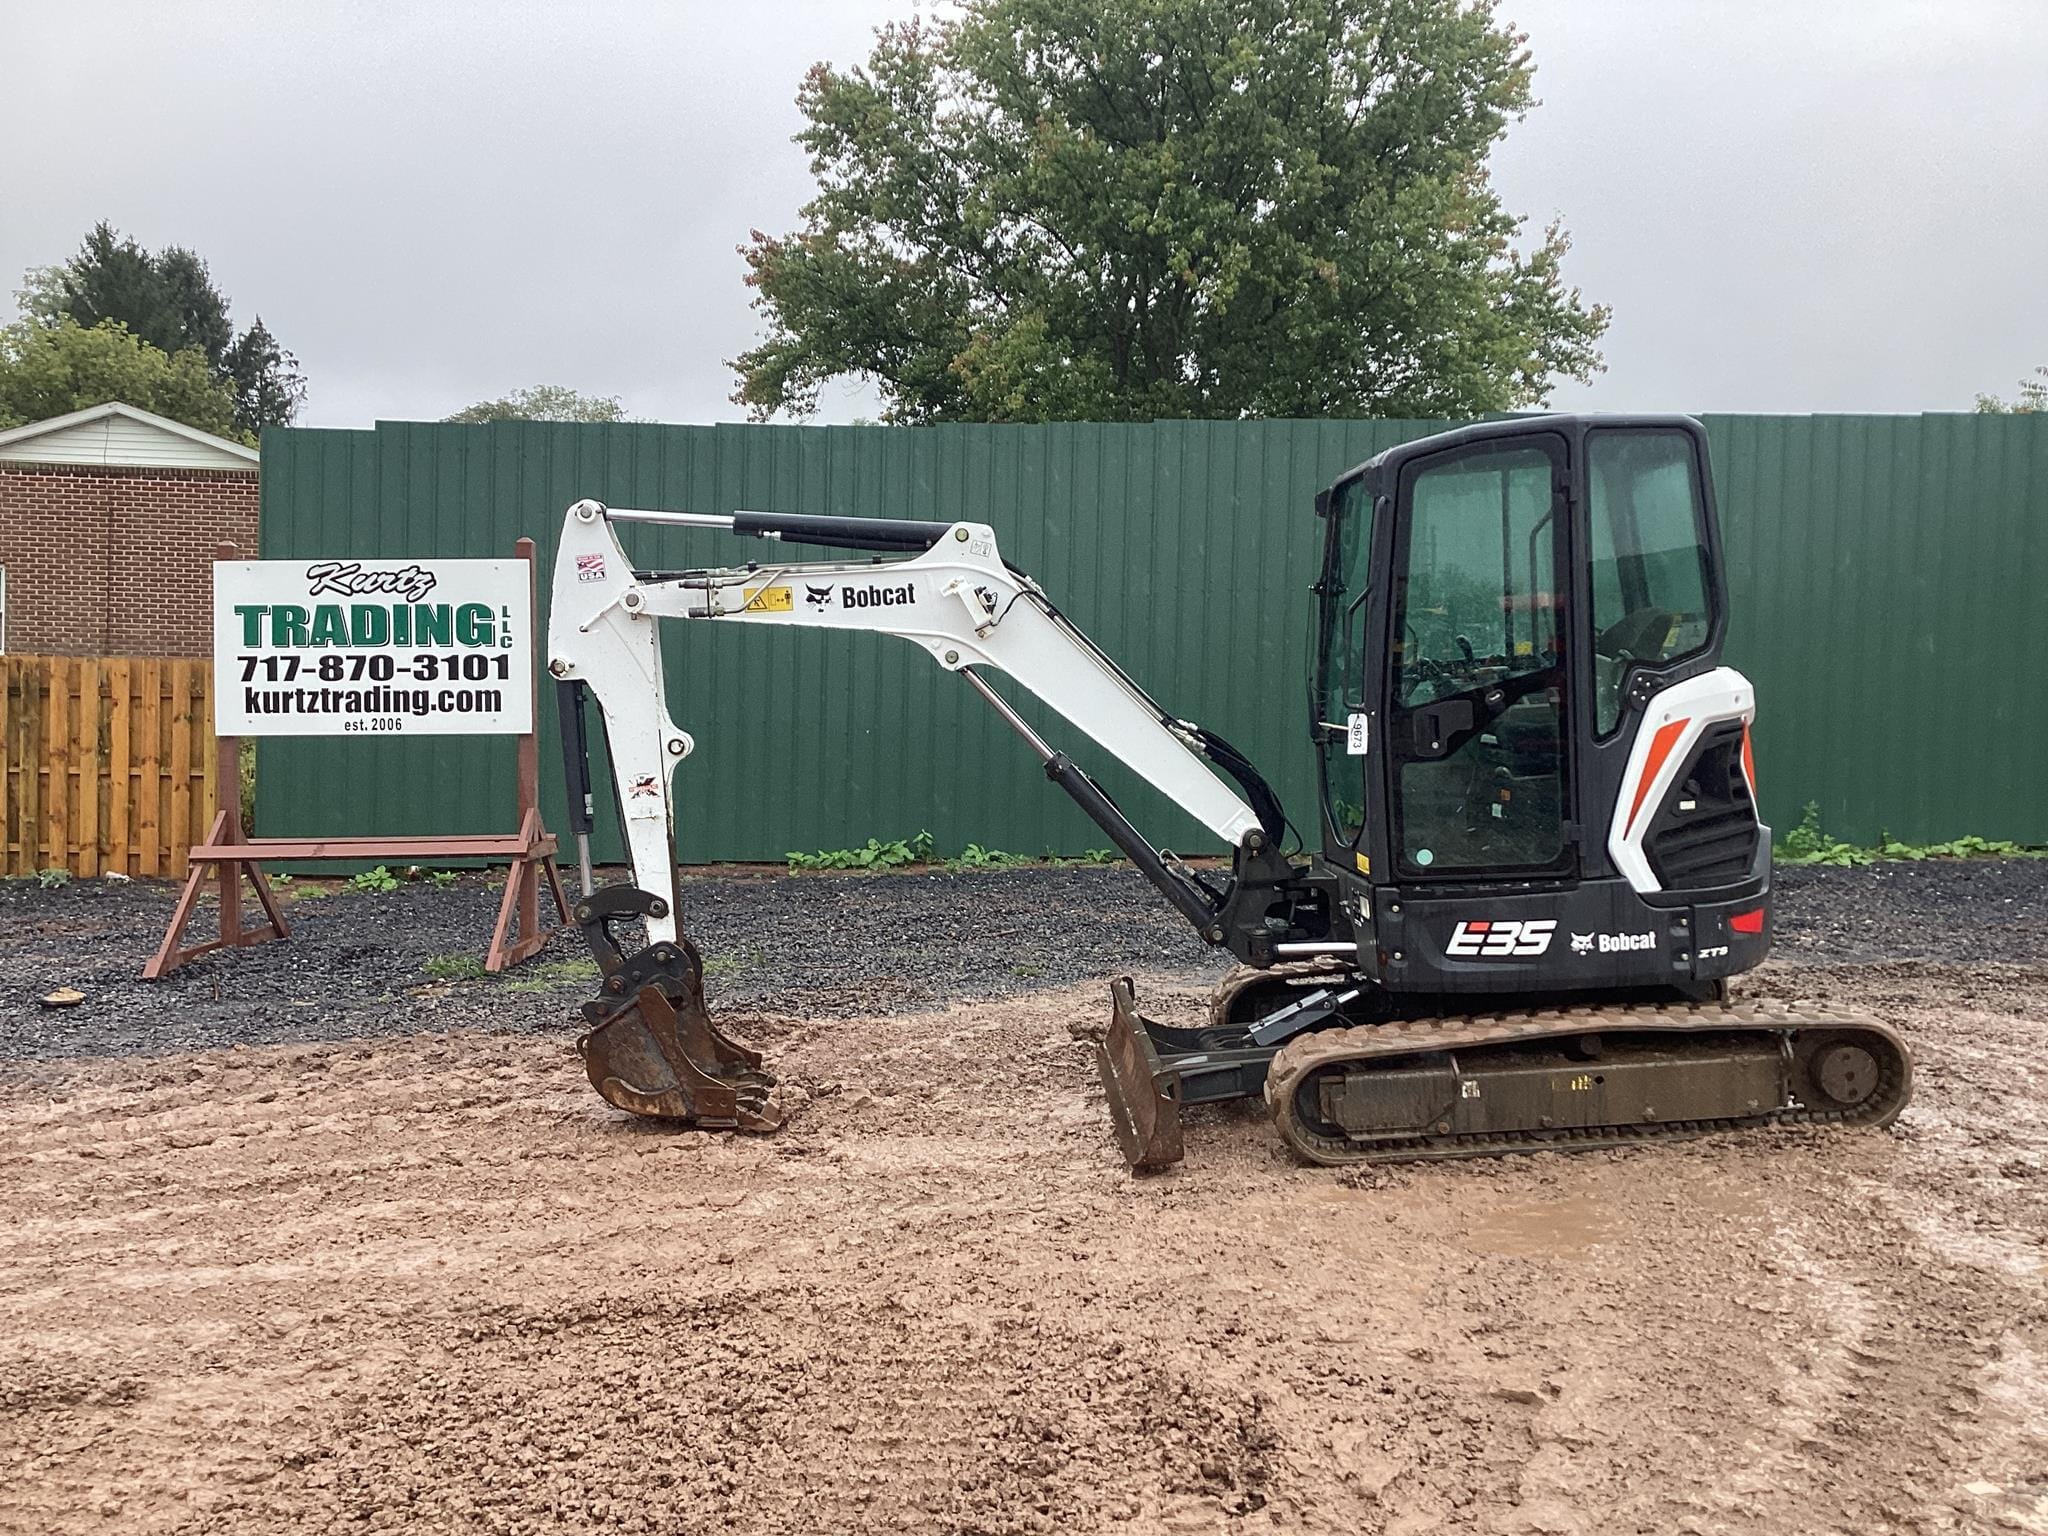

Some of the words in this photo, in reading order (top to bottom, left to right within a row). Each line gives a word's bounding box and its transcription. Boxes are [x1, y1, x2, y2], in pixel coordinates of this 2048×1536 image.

[306, 563, 436, 602] Kurtz
[579, 571, 605, 580] USA
[842, 582, 916, 609] Bobcat
[234, 604, 496, 648] TRADING
[501, 605, 513, 648] LLC
[237, 654, 509, 682] 717-870-3101
[245, 686, 502, 716] kurtztrading.com
[344, 719, 368, 732] est.
[371, 718, 402, 731] 2006
[1353, 723, 1362, 748] 9673
[1445, 919, 1557, 956] E35
[1599, 931, 1657, 953] Bobcat
